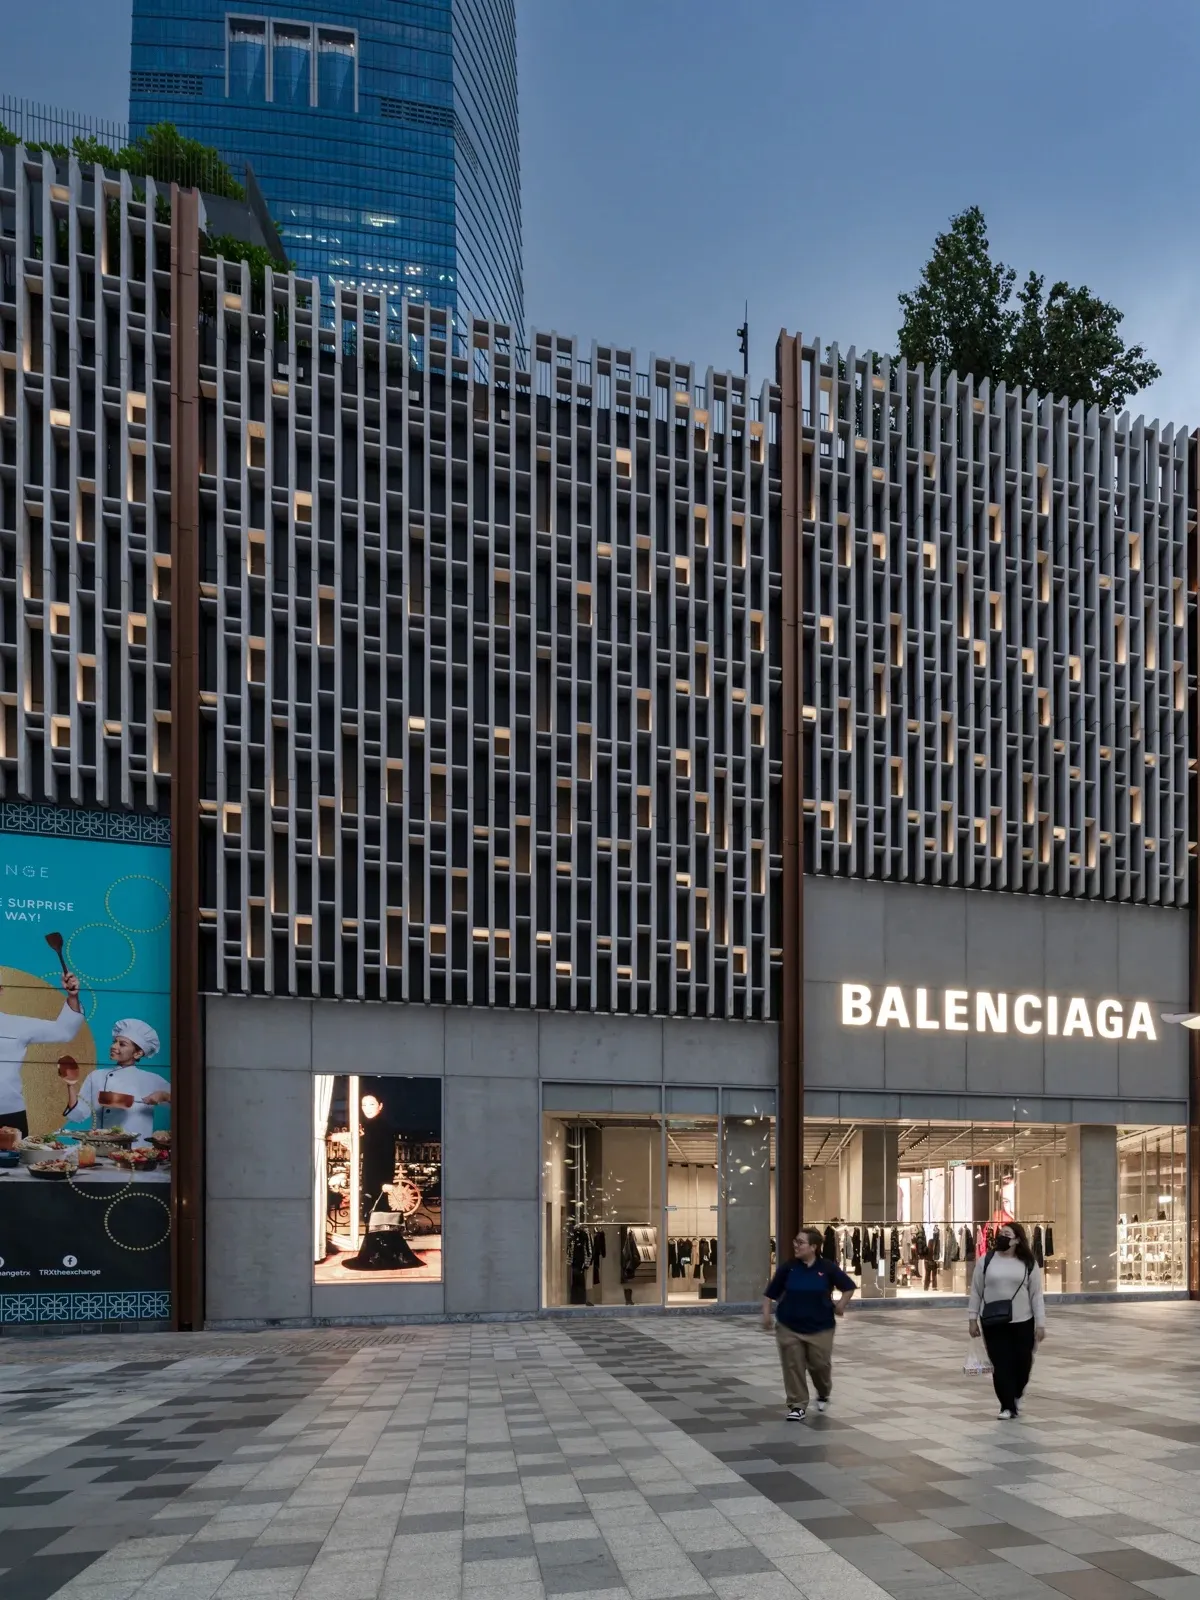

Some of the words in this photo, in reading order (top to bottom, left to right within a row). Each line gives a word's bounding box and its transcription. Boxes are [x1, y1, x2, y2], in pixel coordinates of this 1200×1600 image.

[8, 898, 74, 912] SURPRISE
[5, 911, 41, 922] WAY!
[841, 983, 1158, 1041] BALENCIAGA
